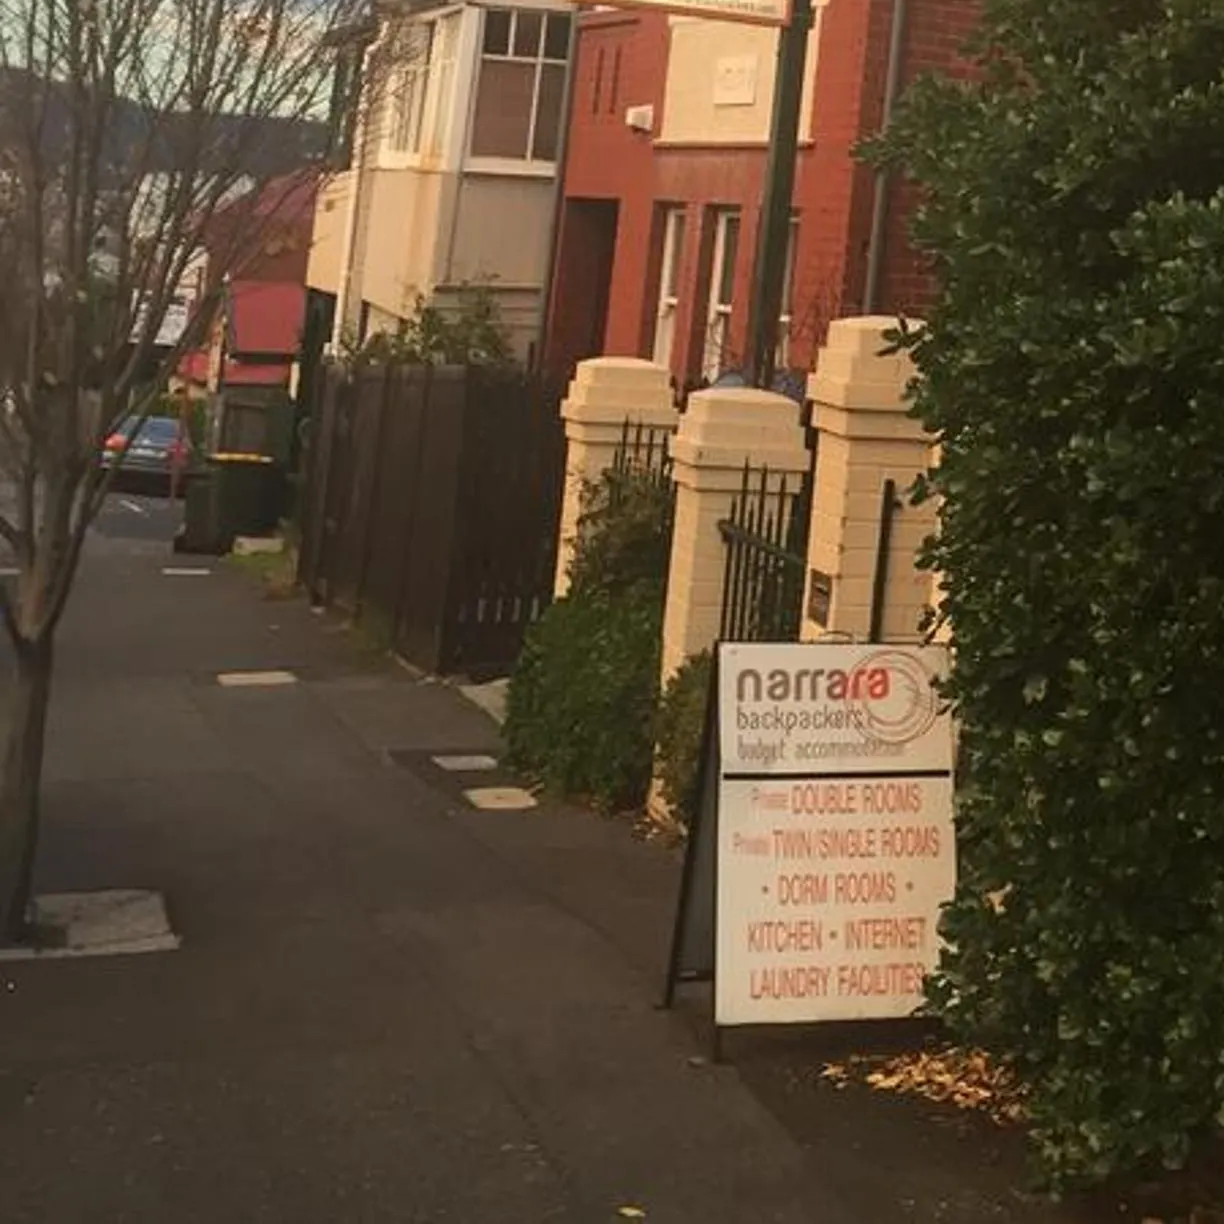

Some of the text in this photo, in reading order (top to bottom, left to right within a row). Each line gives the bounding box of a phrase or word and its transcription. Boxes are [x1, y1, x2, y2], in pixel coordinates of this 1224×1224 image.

[735, 667, 891, 703] narrara
[736, 704, 865, 736] backpackers
[737, 733, 786, 764] budget
[795, 737, 906, 758] accommod
[791, 784, 857, 814] DOUBLE
[861, 782, 922, 813] ROOMS
[880, 825, 941, 858] ROOMS
[778, 871, 897, 905] DORM ROOMS
[747, 915, 927, 952] KITCHEN INTERNET
[750, 966, 831, 999] LAUNDRY
